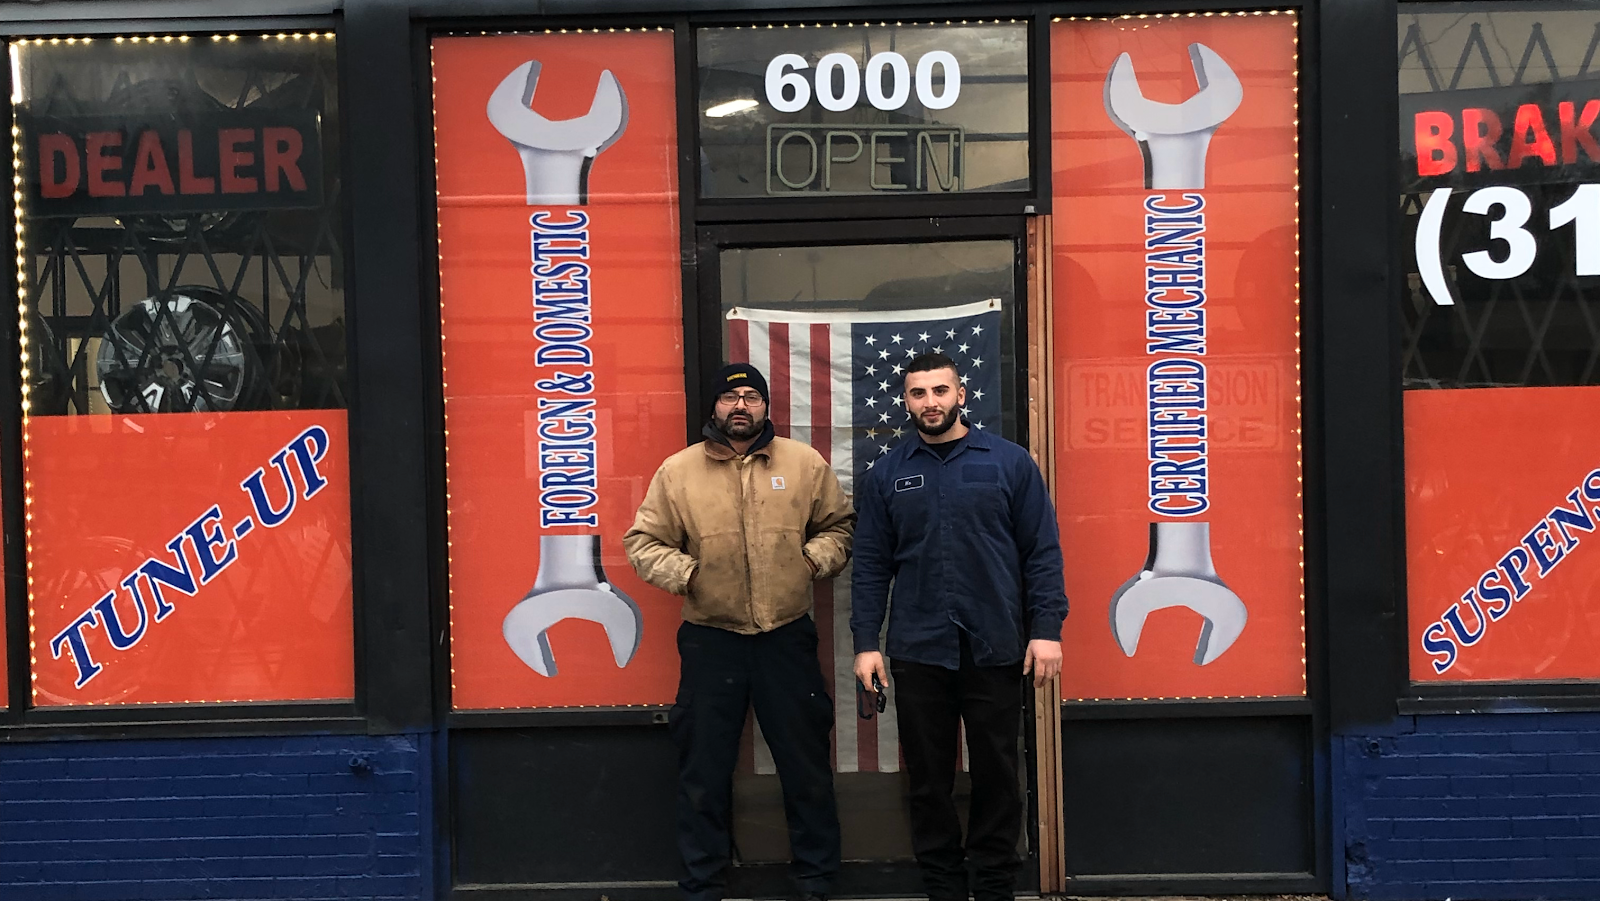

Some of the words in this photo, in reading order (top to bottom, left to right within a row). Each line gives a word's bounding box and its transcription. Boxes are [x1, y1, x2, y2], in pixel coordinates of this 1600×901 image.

[765, 50, 962, 113] 6000
[38, 126, 308, 199] DEALER
[776, 130, 954, 191] OPEN
[1415, 99, 1600, 177] BRAK
[1144, 193, 1207, 356] MECHANIC
[1415, 183, 1600, 306] (31
[529, 210, 593, 367] DOMESTIC
[534, 371, 595, 395] &
[1079, 369, 1269, 408] TRANSION
[537, 398, 599, 528] FOREIGN
[1084, 416, 1265, 444] SECE
[1147, 358, 1210, 517] CERTIFIED
[50, 425, 330, 690] TUNE-UP
